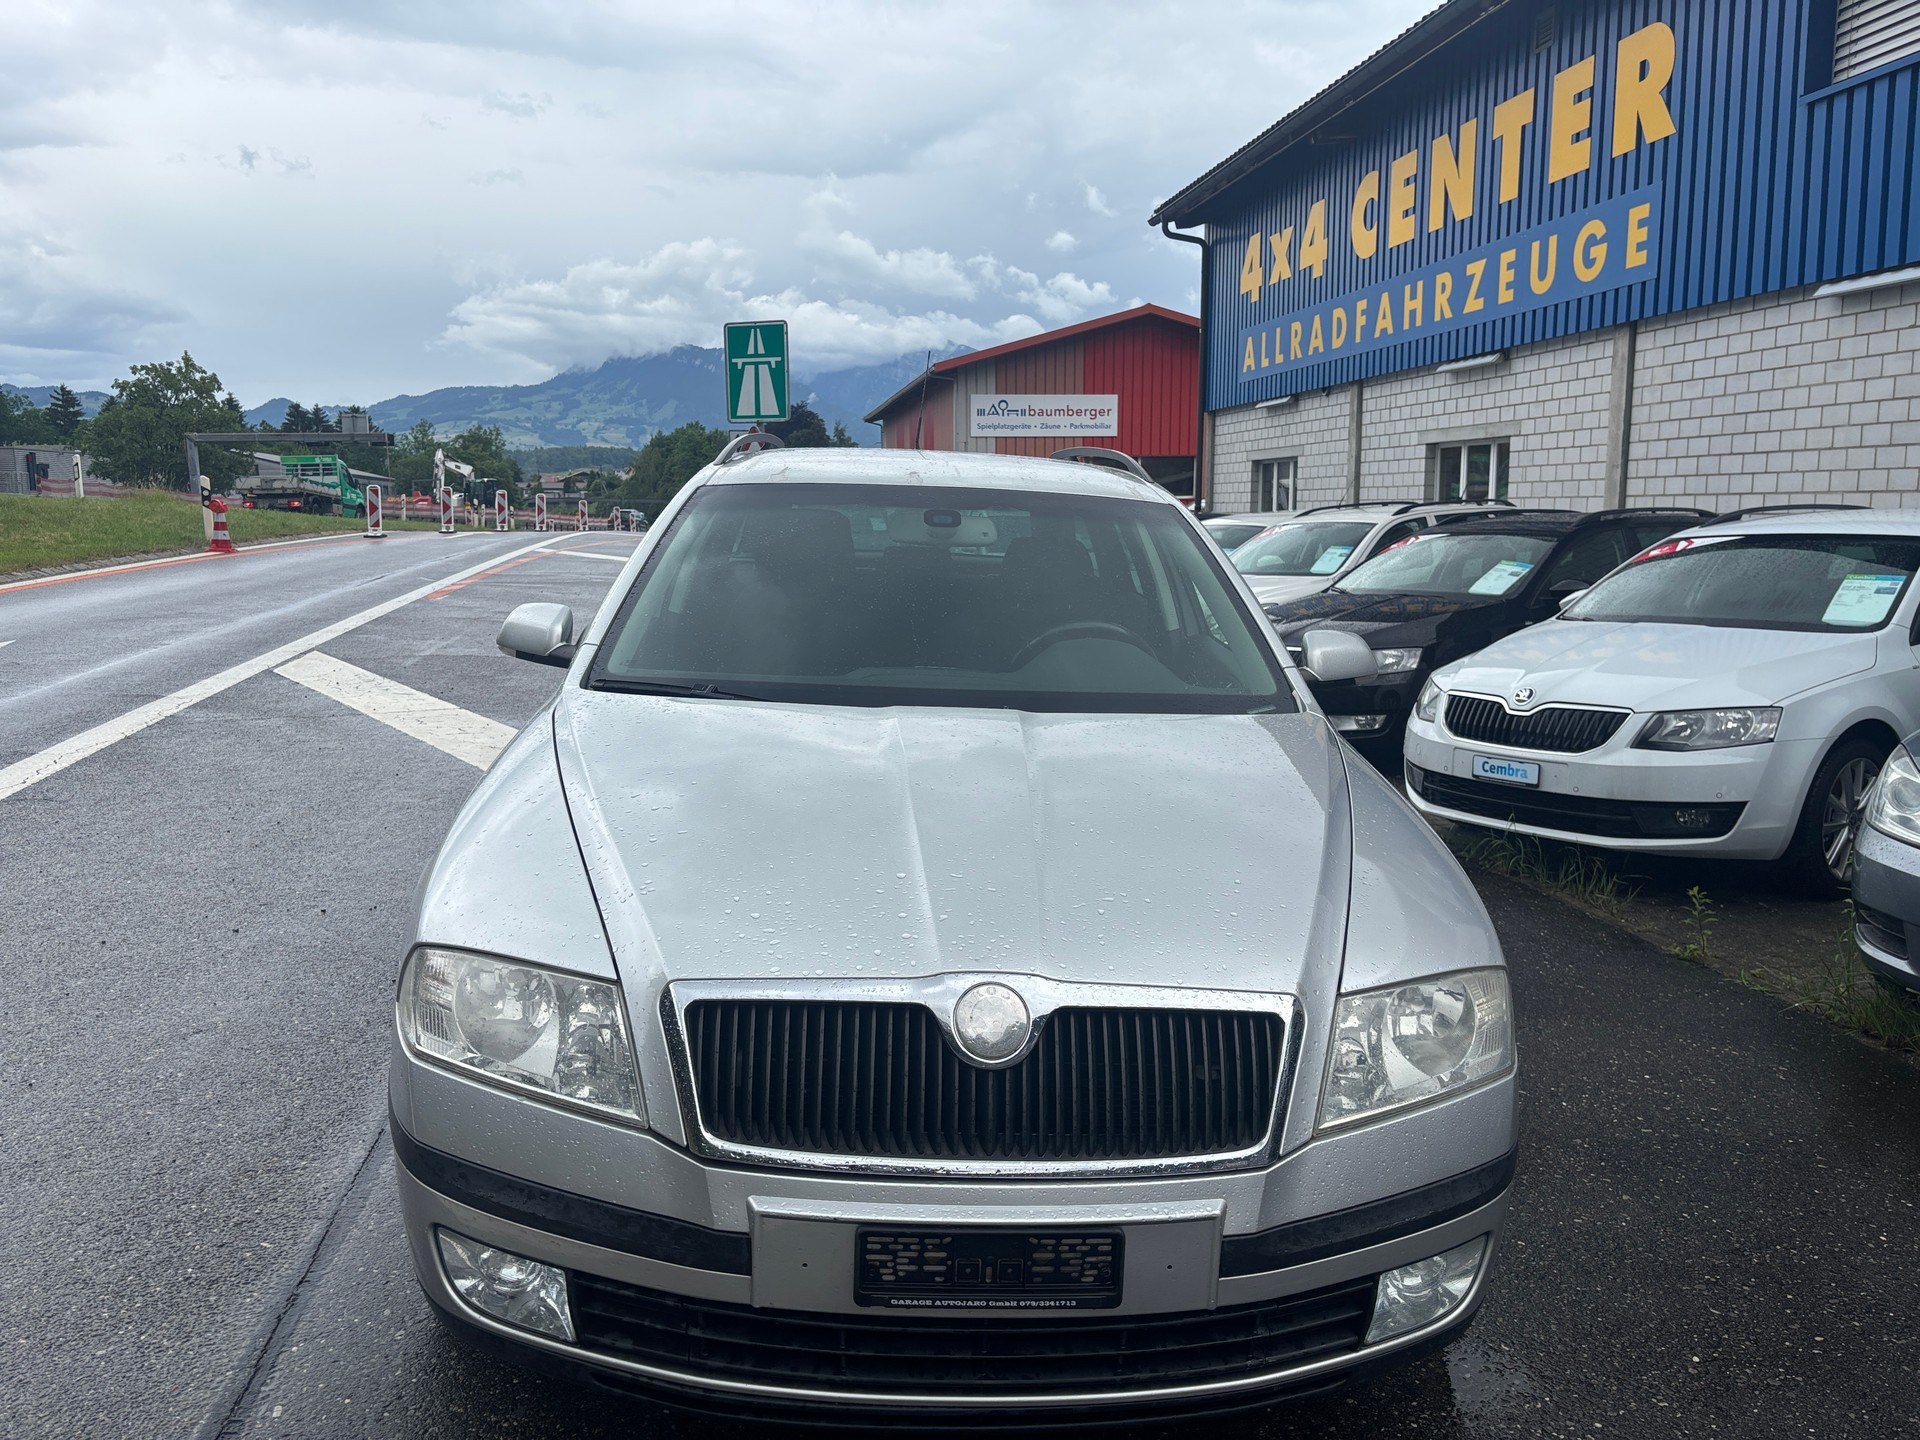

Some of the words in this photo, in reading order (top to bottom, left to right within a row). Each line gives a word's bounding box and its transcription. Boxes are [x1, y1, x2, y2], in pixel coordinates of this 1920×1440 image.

[1240, 198, 1328, 303] 4x4
[1350, 21, 1677, 260] CENTER
[1242, 202, 1651, 373] ALLRADFAHRZEUGE
[1028, 405, 1112, 420] baumberger
[976, 422, 1032, 431] Spielplatzgeräte
[1040, 422, 1061, 430] Zäune
[1069, 422, 1112, 430] Parkmobiliar
[1481, 761, 1529, 779] Cembra
